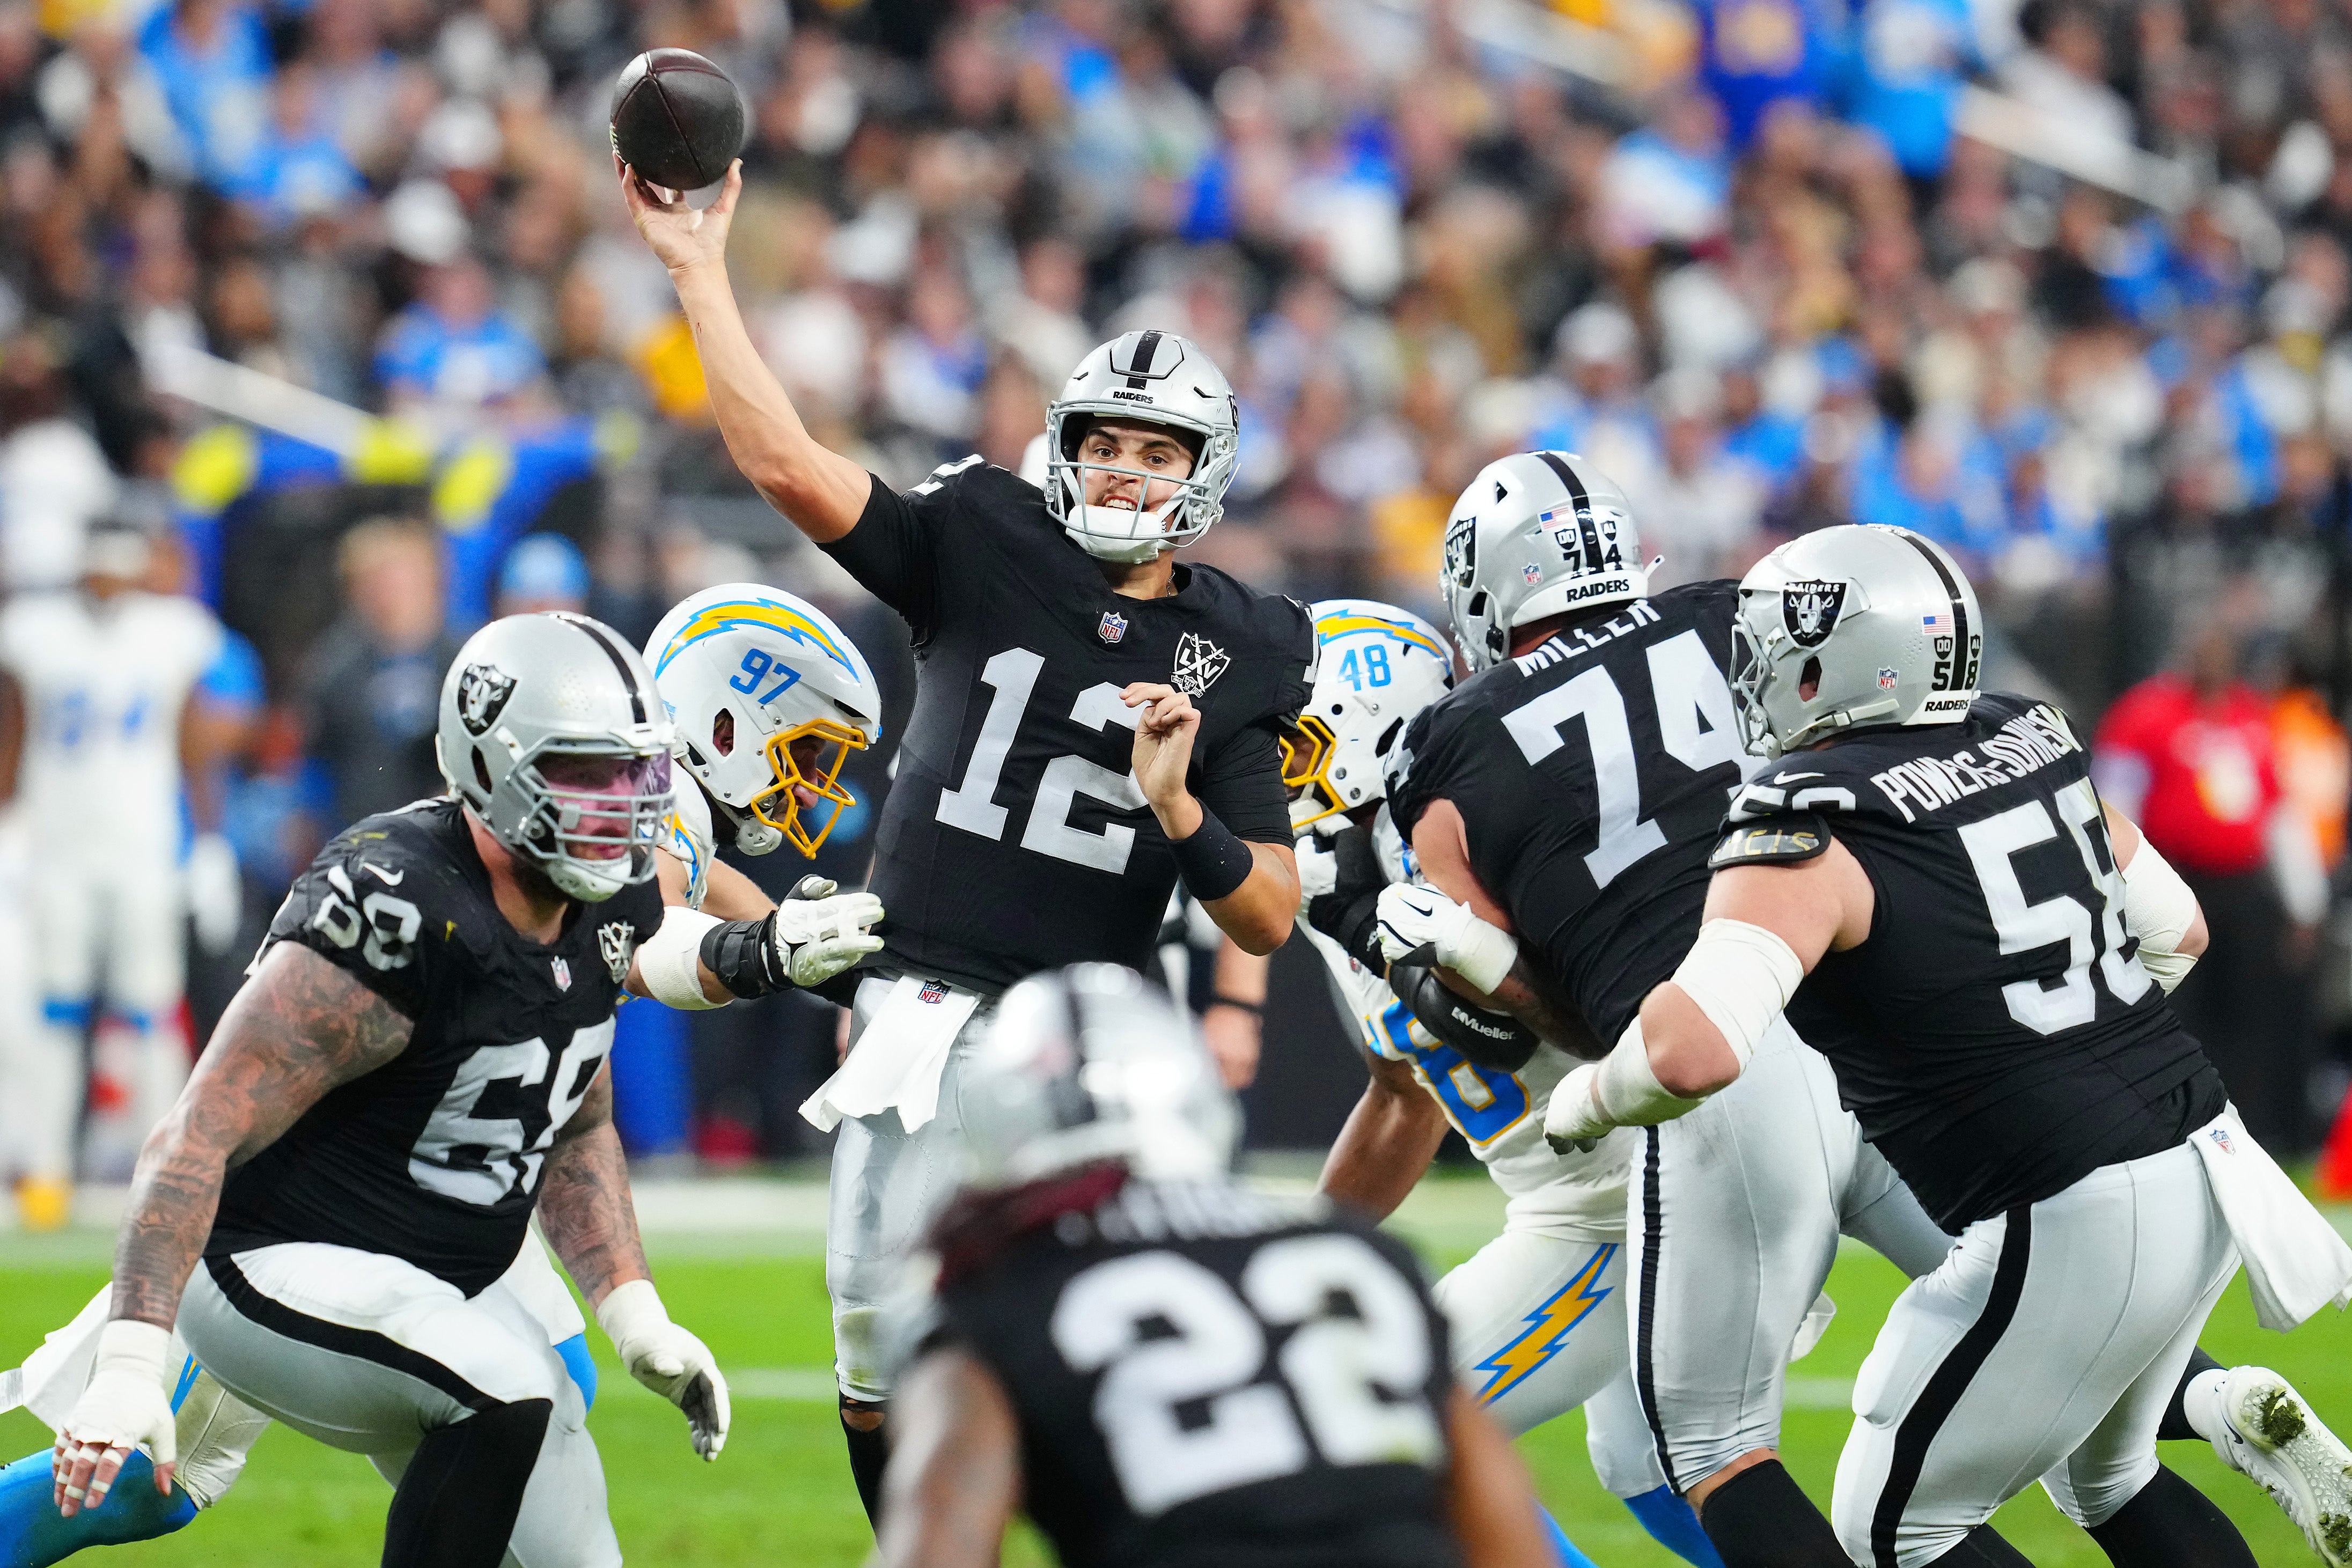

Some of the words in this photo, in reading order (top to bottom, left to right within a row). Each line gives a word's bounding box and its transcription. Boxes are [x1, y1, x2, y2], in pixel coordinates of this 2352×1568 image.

[1113, 391, 1153, 404] RAIDERS
[1526, 572, 1541, 584] NFL
[1567, 579, 1629, 603] RAIDERS
[1102, 624, 1119, 639] NFL
[730, 648, 802, 705] 97
[1337, 644, 1392, 692] 48
[1880, 677, 1896, 689] NFL
[1924, 699, 1969, 712] RAIDERS
[935, 646, 1156, 875] 12
[1501, 628, 1772, 890] 74
[313, 865, 422, 971] 68
[1957, 776, 2153, 1036] 58
[920, 990, 942, 1003] NFL
[1459, 1012, 1515, 1040] Mueller
[408, 1014, 617, 1206] 68
[1050, 1233, 1449, 1519] 22
